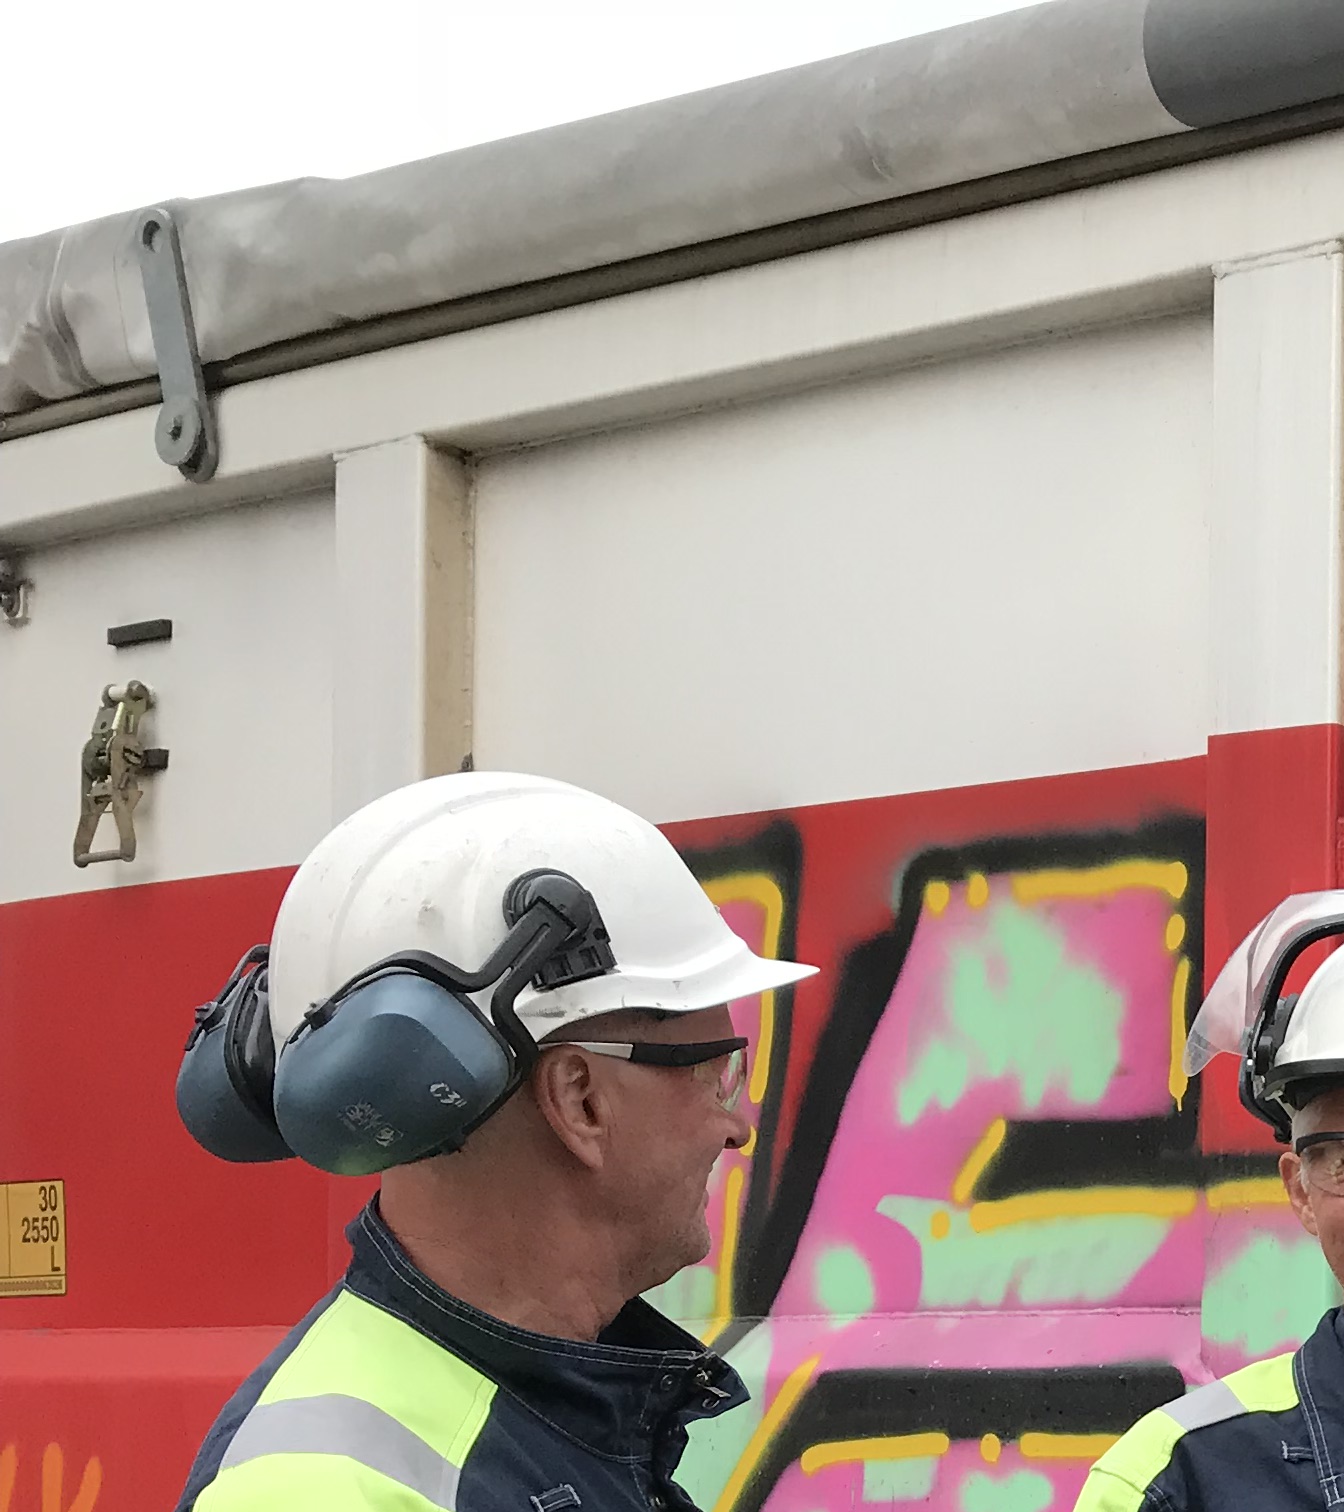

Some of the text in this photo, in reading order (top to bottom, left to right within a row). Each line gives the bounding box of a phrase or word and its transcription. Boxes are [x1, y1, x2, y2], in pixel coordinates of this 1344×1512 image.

[38, 1184, 58, 1213] 30
[21, 1215, 60, 1243] 2550
[50, 1244, 61, 1272] L
